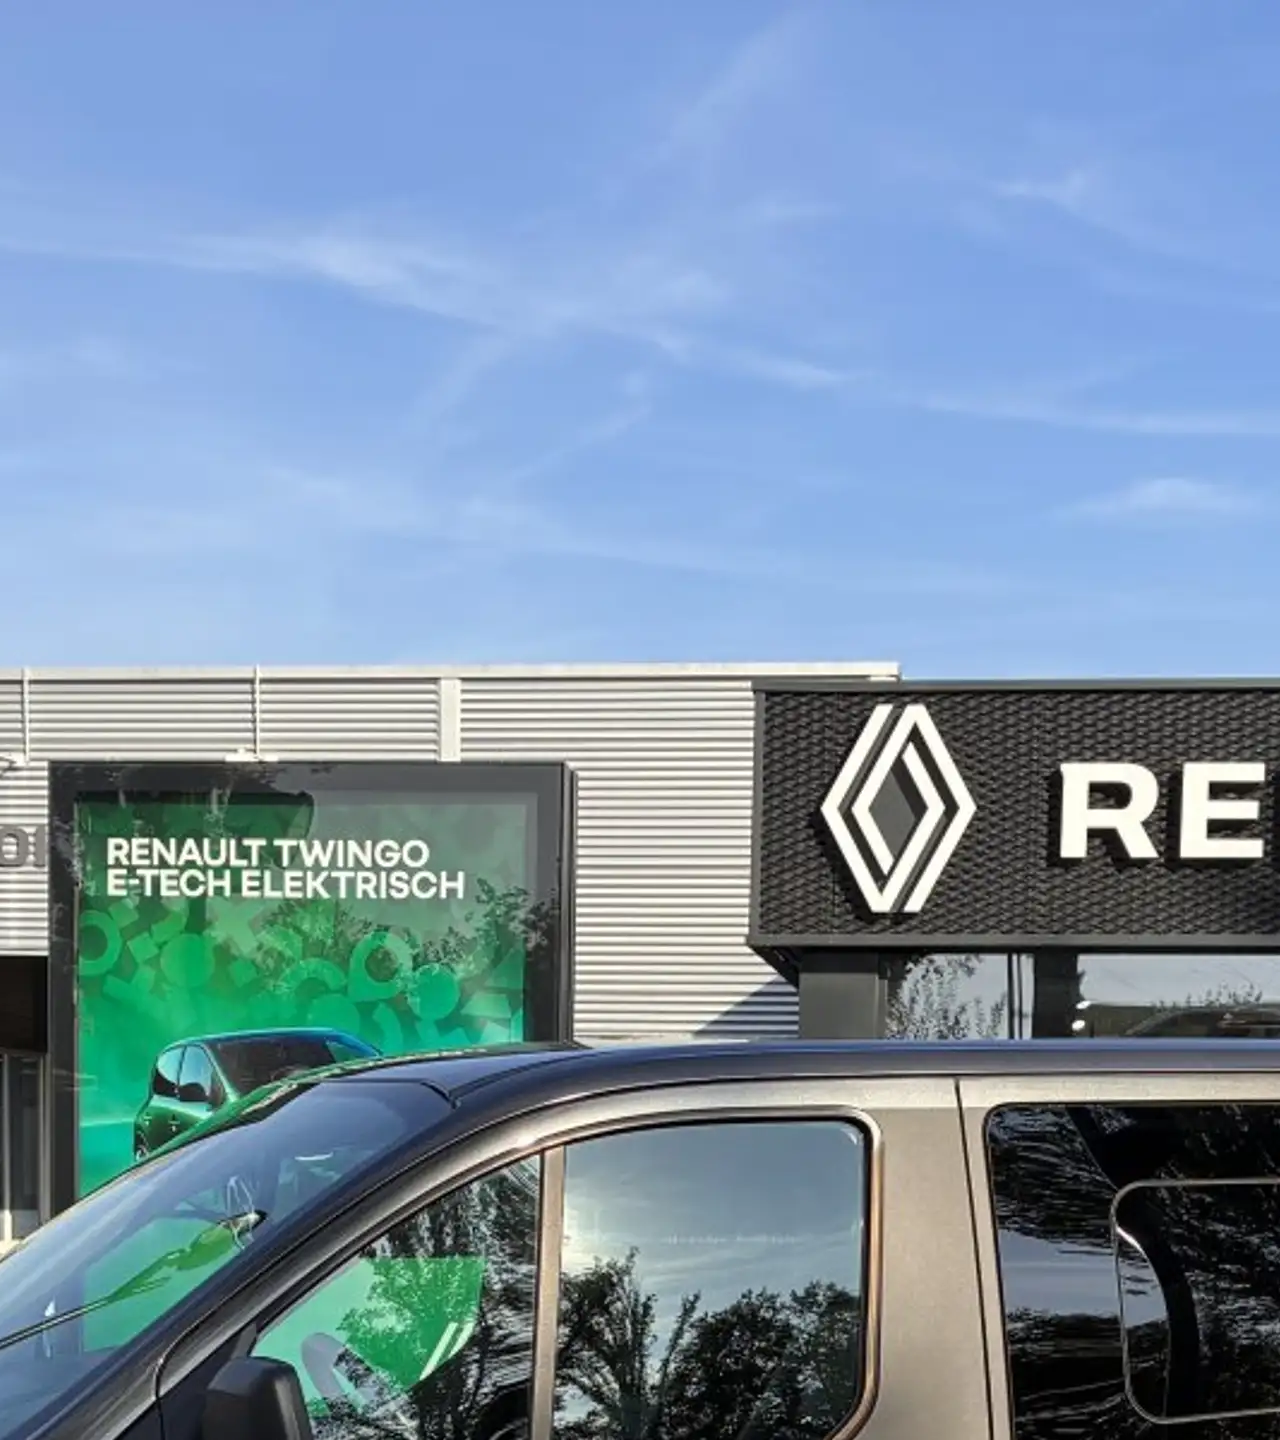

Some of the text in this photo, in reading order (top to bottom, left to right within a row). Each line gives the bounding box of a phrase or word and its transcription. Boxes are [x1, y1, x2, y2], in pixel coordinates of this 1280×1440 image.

[107, 838, 430, 868] RENAULT TWINGO
[107, 869, 465, 899] E-TECH ELEKTRISCH
